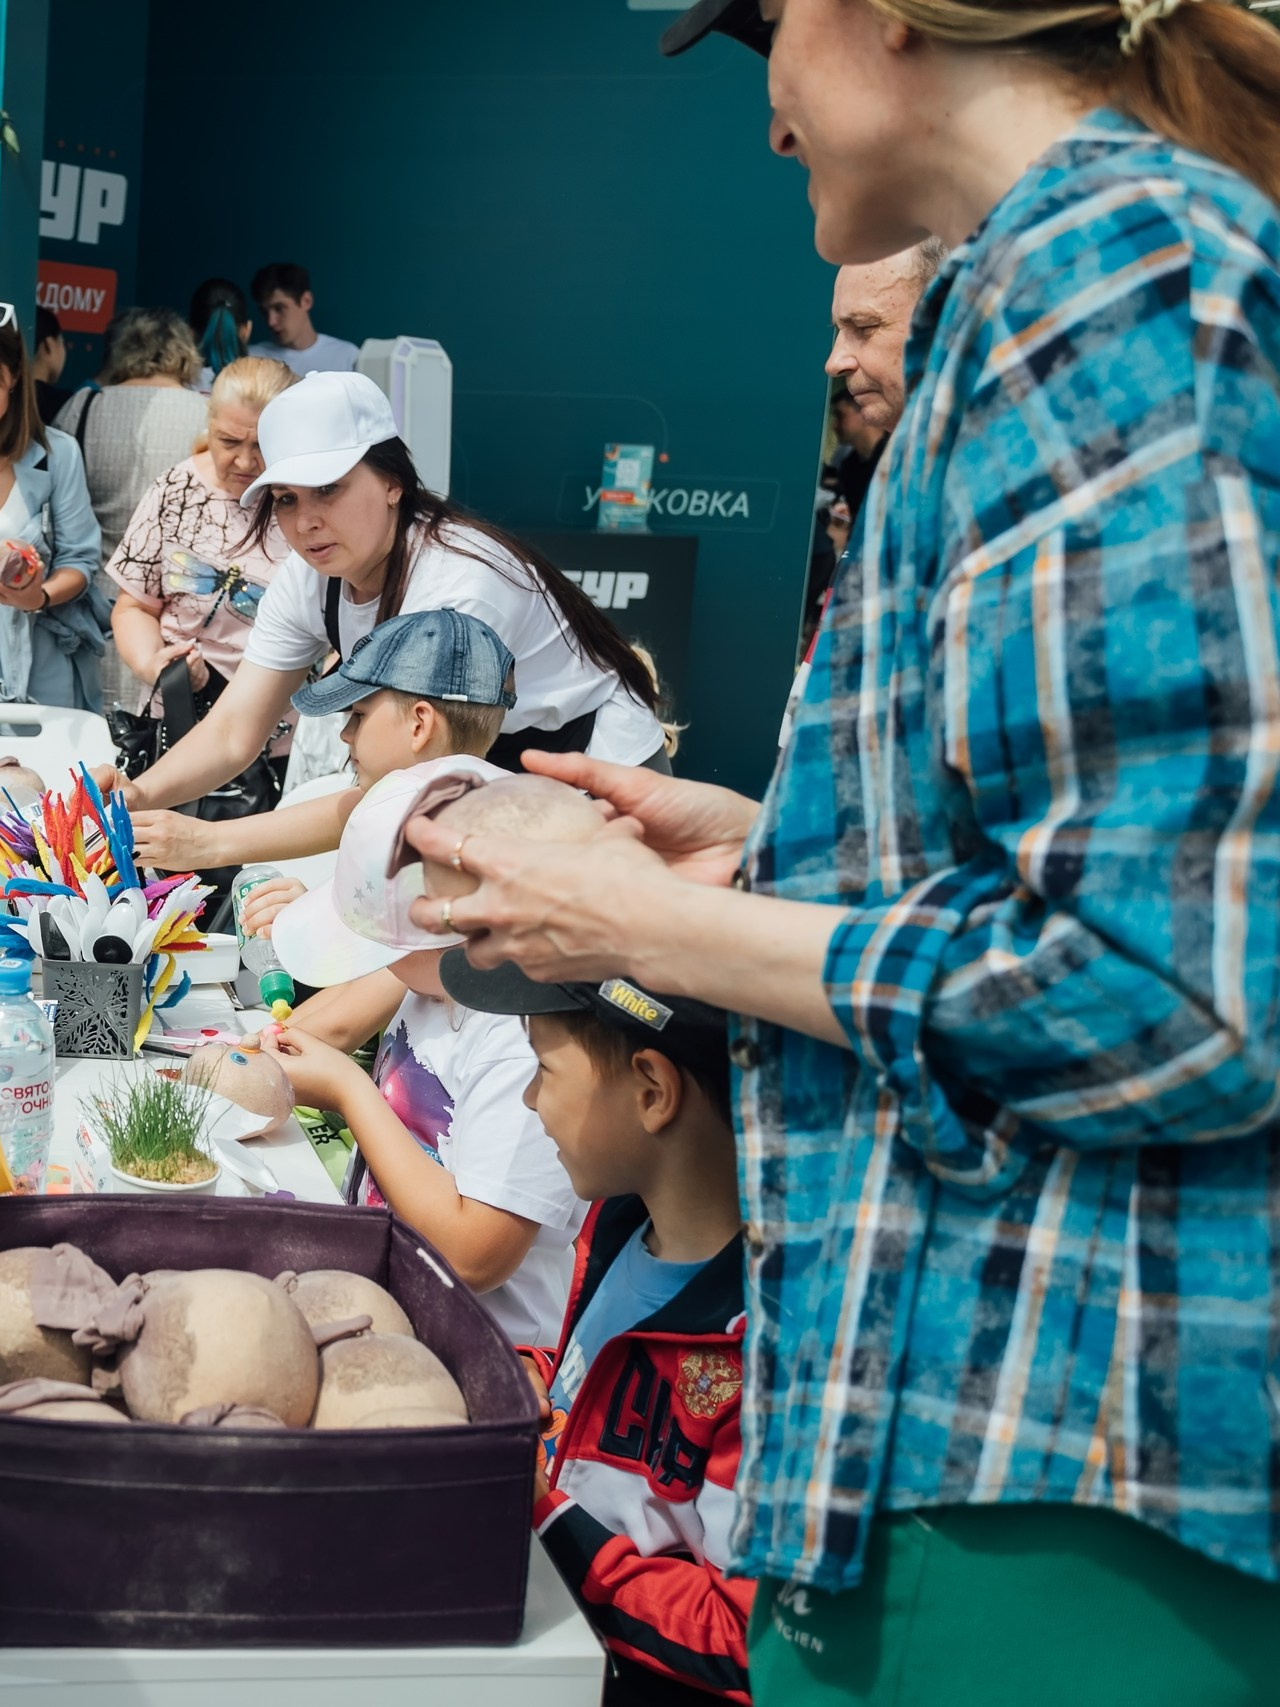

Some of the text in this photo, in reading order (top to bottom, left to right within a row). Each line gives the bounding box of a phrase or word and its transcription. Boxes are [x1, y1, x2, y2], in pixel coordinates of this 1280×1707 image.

[582, 485, 750, 519] УКОВКА
[610, 982, 658, 1021] White
[0, 1080, 52, 1100] СВЯТО
